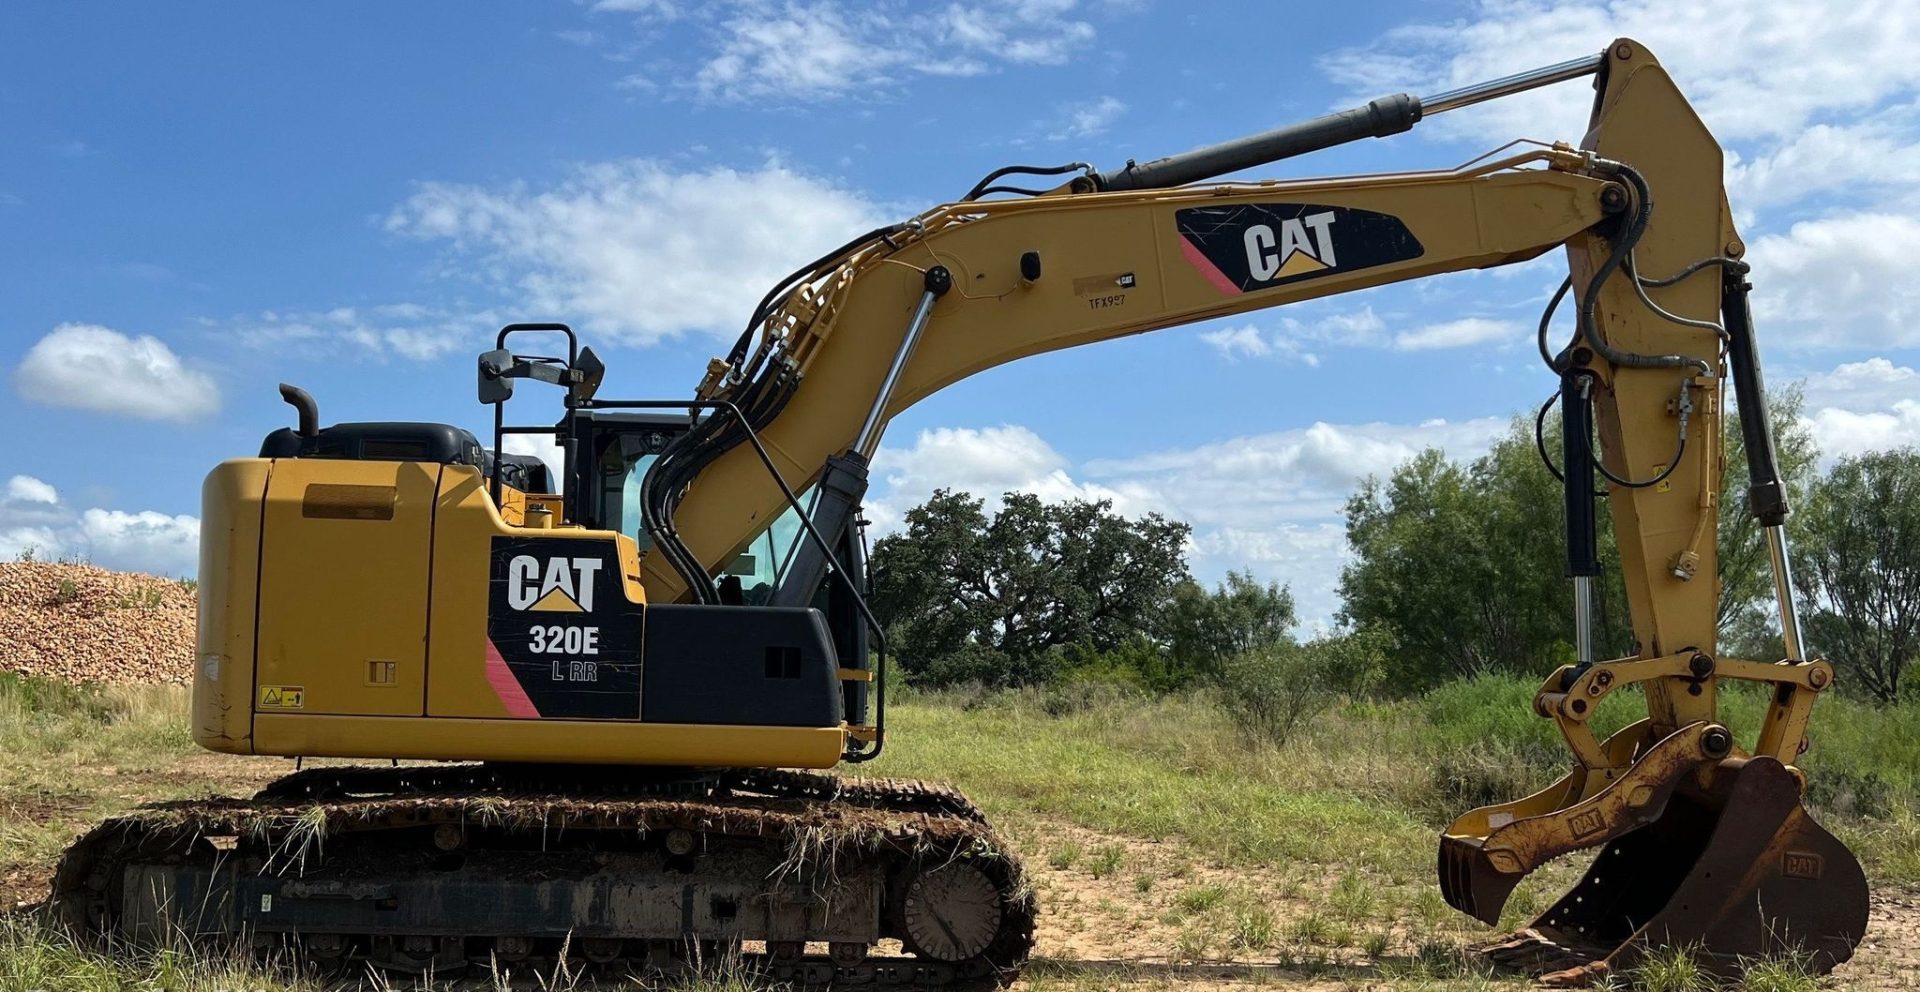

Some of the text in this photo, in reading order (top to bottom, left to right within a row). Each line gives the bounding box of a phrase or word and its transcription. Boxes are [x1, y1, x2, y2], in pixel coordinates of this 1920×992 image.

[1243, 211, 1337, 281] CAT
[1121, 275, 1133, 284] CAT
[508, 554, 603, 613] CAT
[528, 625, 599, 655] 320E
[552, 660, 598, 682] L RR
[1571, 810, 1601, 835] CAT
[1786, 856, 1818, 876] CAT
